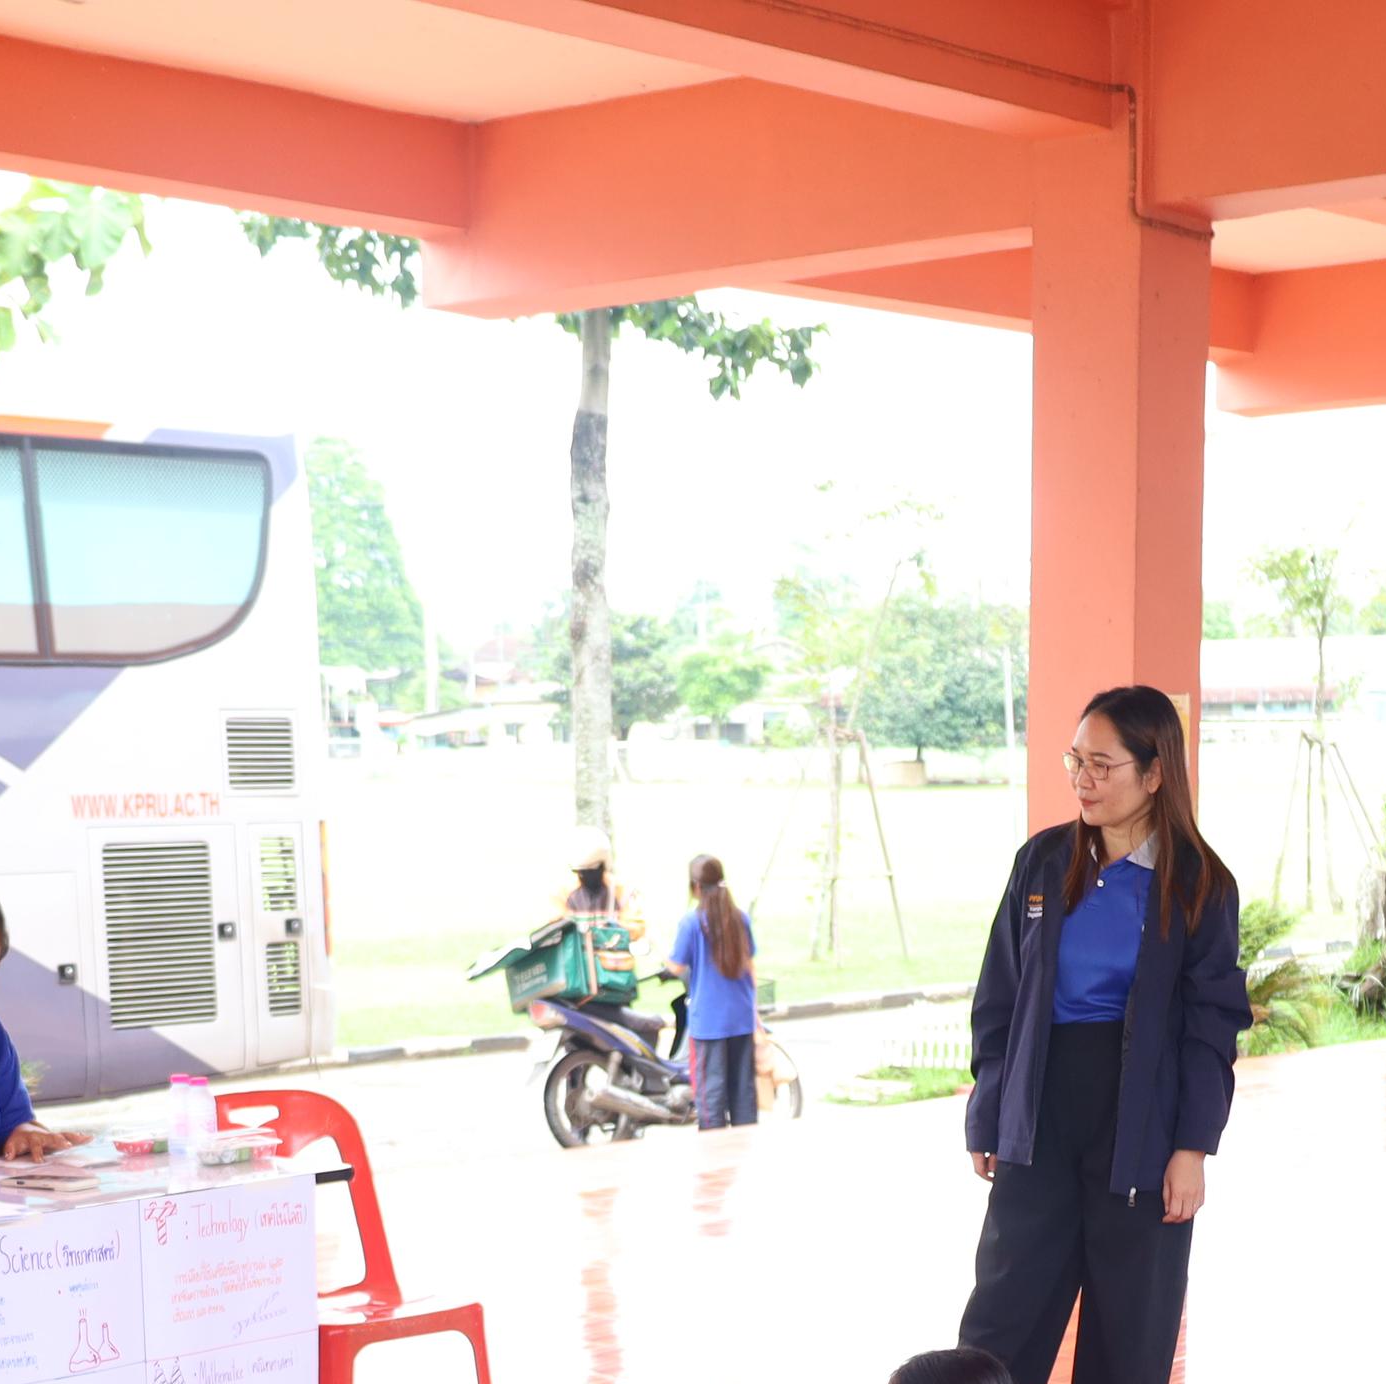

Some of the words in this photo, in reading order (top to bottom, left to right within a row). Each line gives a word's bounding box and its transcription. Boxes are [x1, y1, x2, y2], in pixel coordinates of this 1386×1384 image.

[70, 792, 220, 819] WWW.KPRU.AC.TH
[190, 1199, 250, 1244] Technology
[0, 1234, 53, 1275] Science
